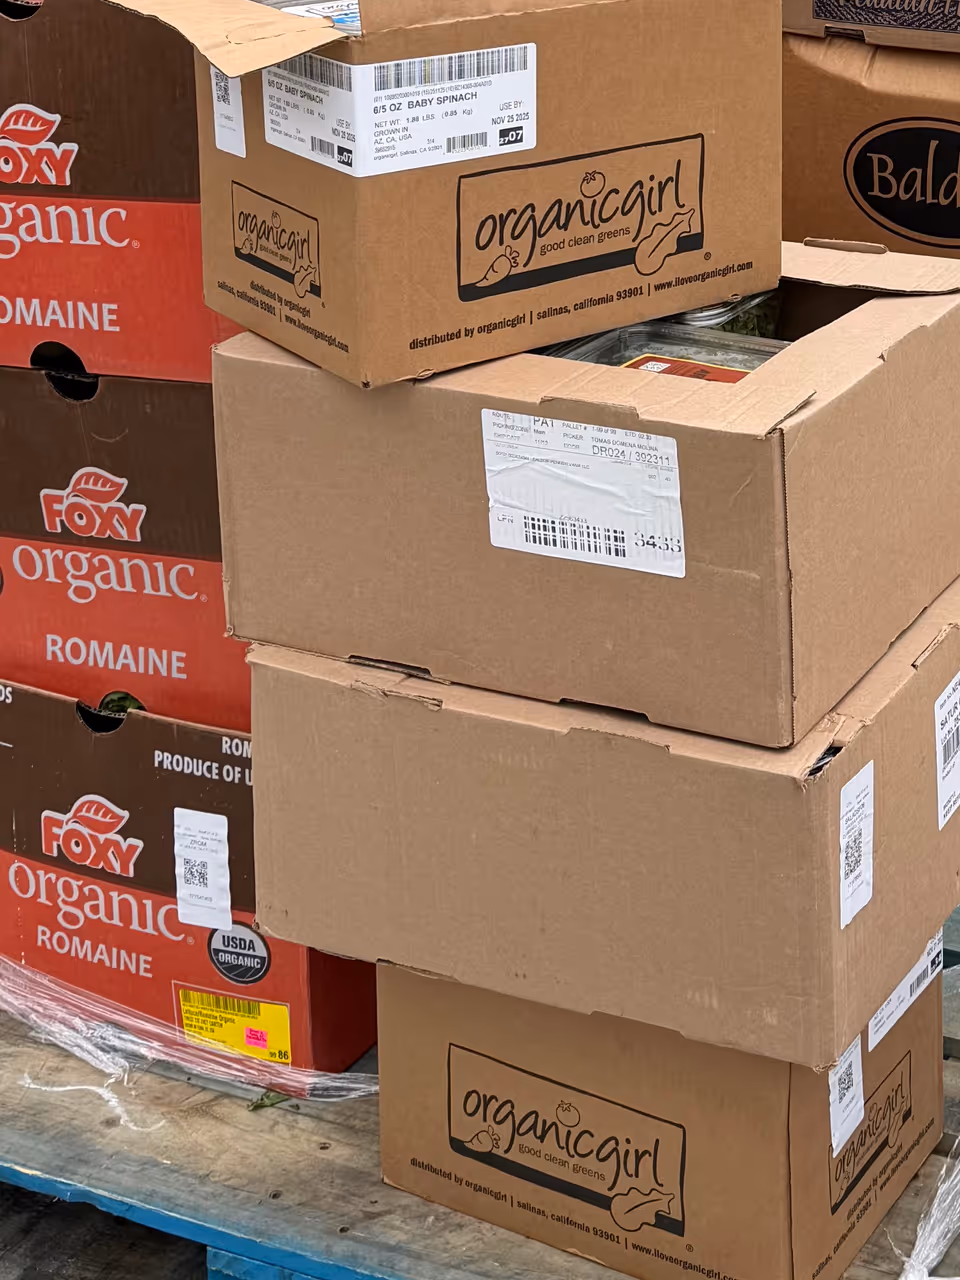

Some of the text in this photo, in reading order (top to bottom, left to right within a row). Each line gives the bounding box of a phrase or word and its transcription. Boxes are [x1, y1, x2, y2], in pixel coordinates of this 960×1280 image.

[373, 105, 387, 115] 6/5
[389, 103, 402, 112] OZ
[408, 99, 433, 109] BABY
[436, 92, 478, 105] SPINACH
[492, 117, 505, 125] NOV
[515, 112, 529, 121] 2025
[499, 103, 511, 111] USE
[374, 128, 399, 137] GROWN
[0, 142, 78, 185] OXY
[0, 202, 130, 259] ganic
[476, 159, 685, 267] organicgirl
[238, 211, 312, 271] organicgirl
[540, 226, 630, 256] good clean greens
[0, 295, 120, 332] OMAINE
[236, 290, 259, 308] california
[260, 301, 276, 316] 93901
[250, 280, 311, 318] distributed organicgirl
[409, 259, 753, 350] distributed by organicgirl salinas, california 93901 www.iloveorganicgirl.com
[592, 445, 626, 460] DR024
[635, 451, 670, 466] 392311
[40, 489, 147, 542] FOXY
[12, 544, 198, 603] organic
[46, 634, 187, 679] ROMAINE
[940, 702, 959, 731] SATUR
[154, 749, 242, 784] PRODUCE OF
[42, 809, 144, 877] FOXY
[8, 861, 184, 941] organic
[37, 925, 153, 978] ROMAINE
[218, 952, 261, 969] ORGANIC
[222, 934, 256, 953] USDA
[463, 1090, 663, 1191] organicgirl
[518, 1143, 606, 1182] good clean greens
[410, 1157, 621, 1245] distributed by organicgirl salinas, california 93901
